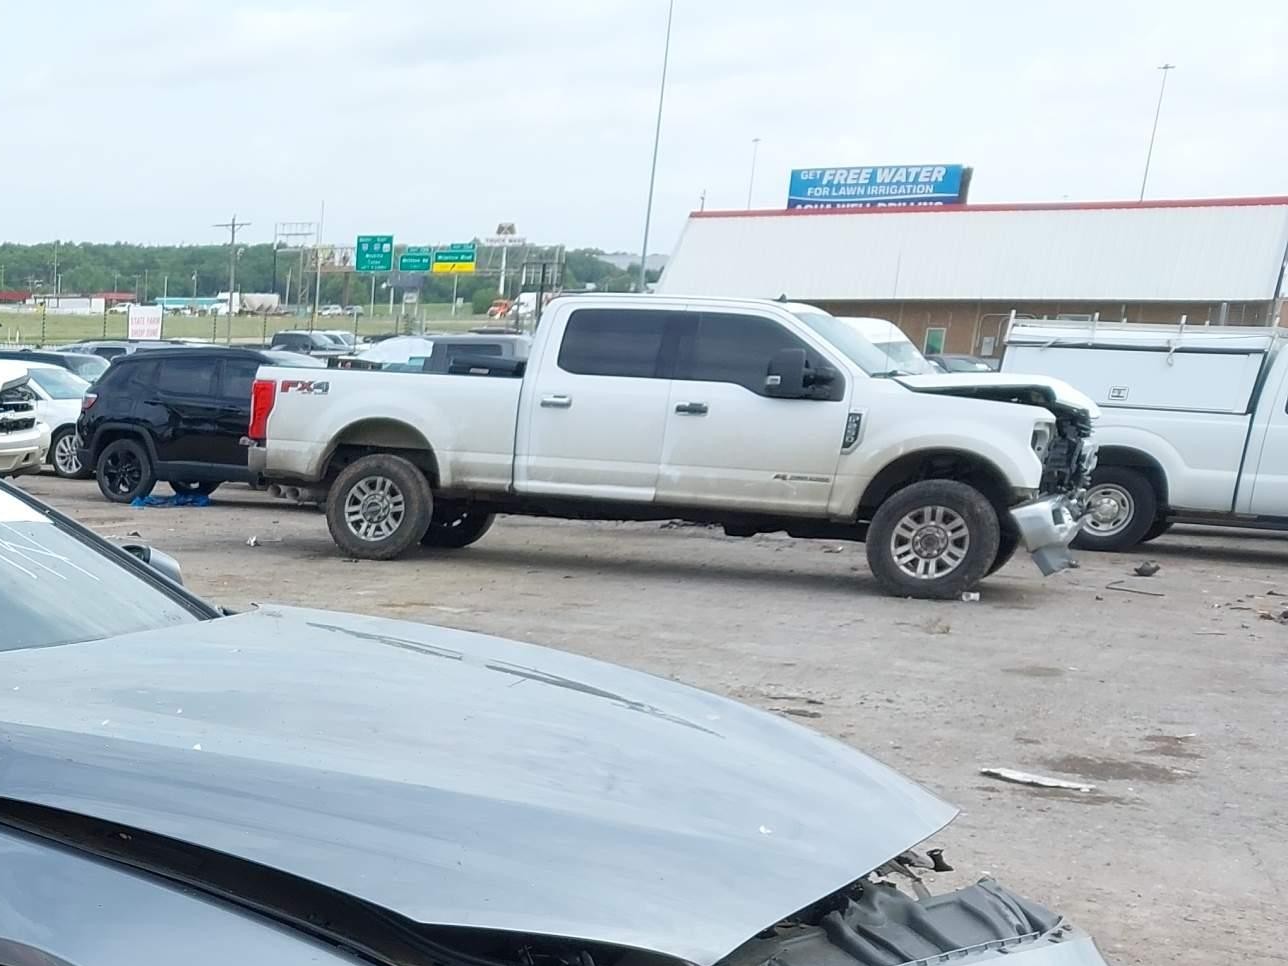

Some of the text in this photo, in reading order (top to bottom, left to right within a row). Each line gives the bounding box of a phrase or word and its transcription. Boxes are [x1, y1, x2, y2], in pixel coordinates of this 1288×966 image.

[800, 166, 946, 185] GET FREE WATER
[807, 184, 934, 197] FOR LAWN IRRIGATION
[281, 380, 329, 393] FX4
